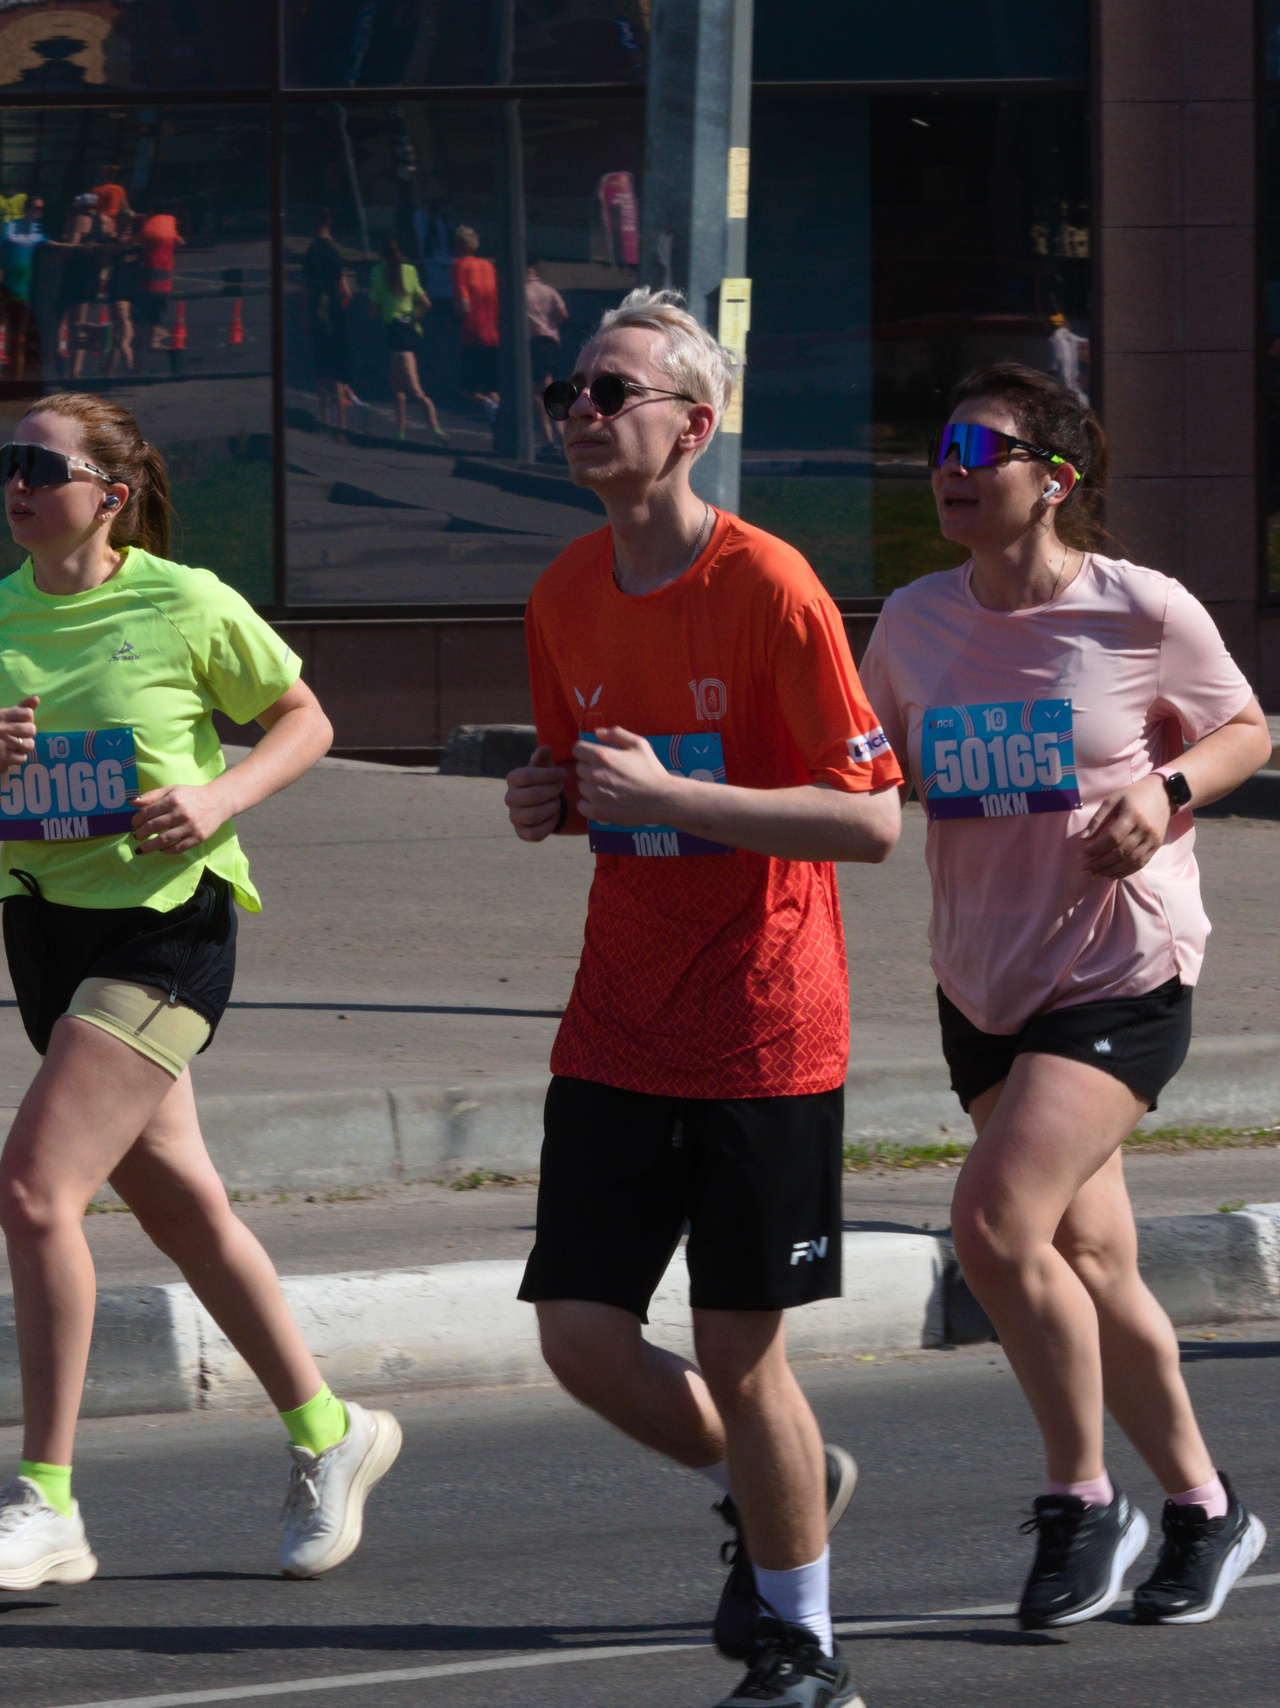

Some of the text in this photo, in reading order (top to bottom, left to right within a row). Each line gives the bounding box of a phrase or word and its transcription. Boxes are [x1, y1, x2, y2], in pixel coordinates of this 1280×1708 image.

[688, 678, 727, 721] 10
[982, 707, 1008, 732] 10
[45, 736, 70, 759] 10
[934, 731, 1064, 794] 50165
[0, 759, 127, 816] 50166
